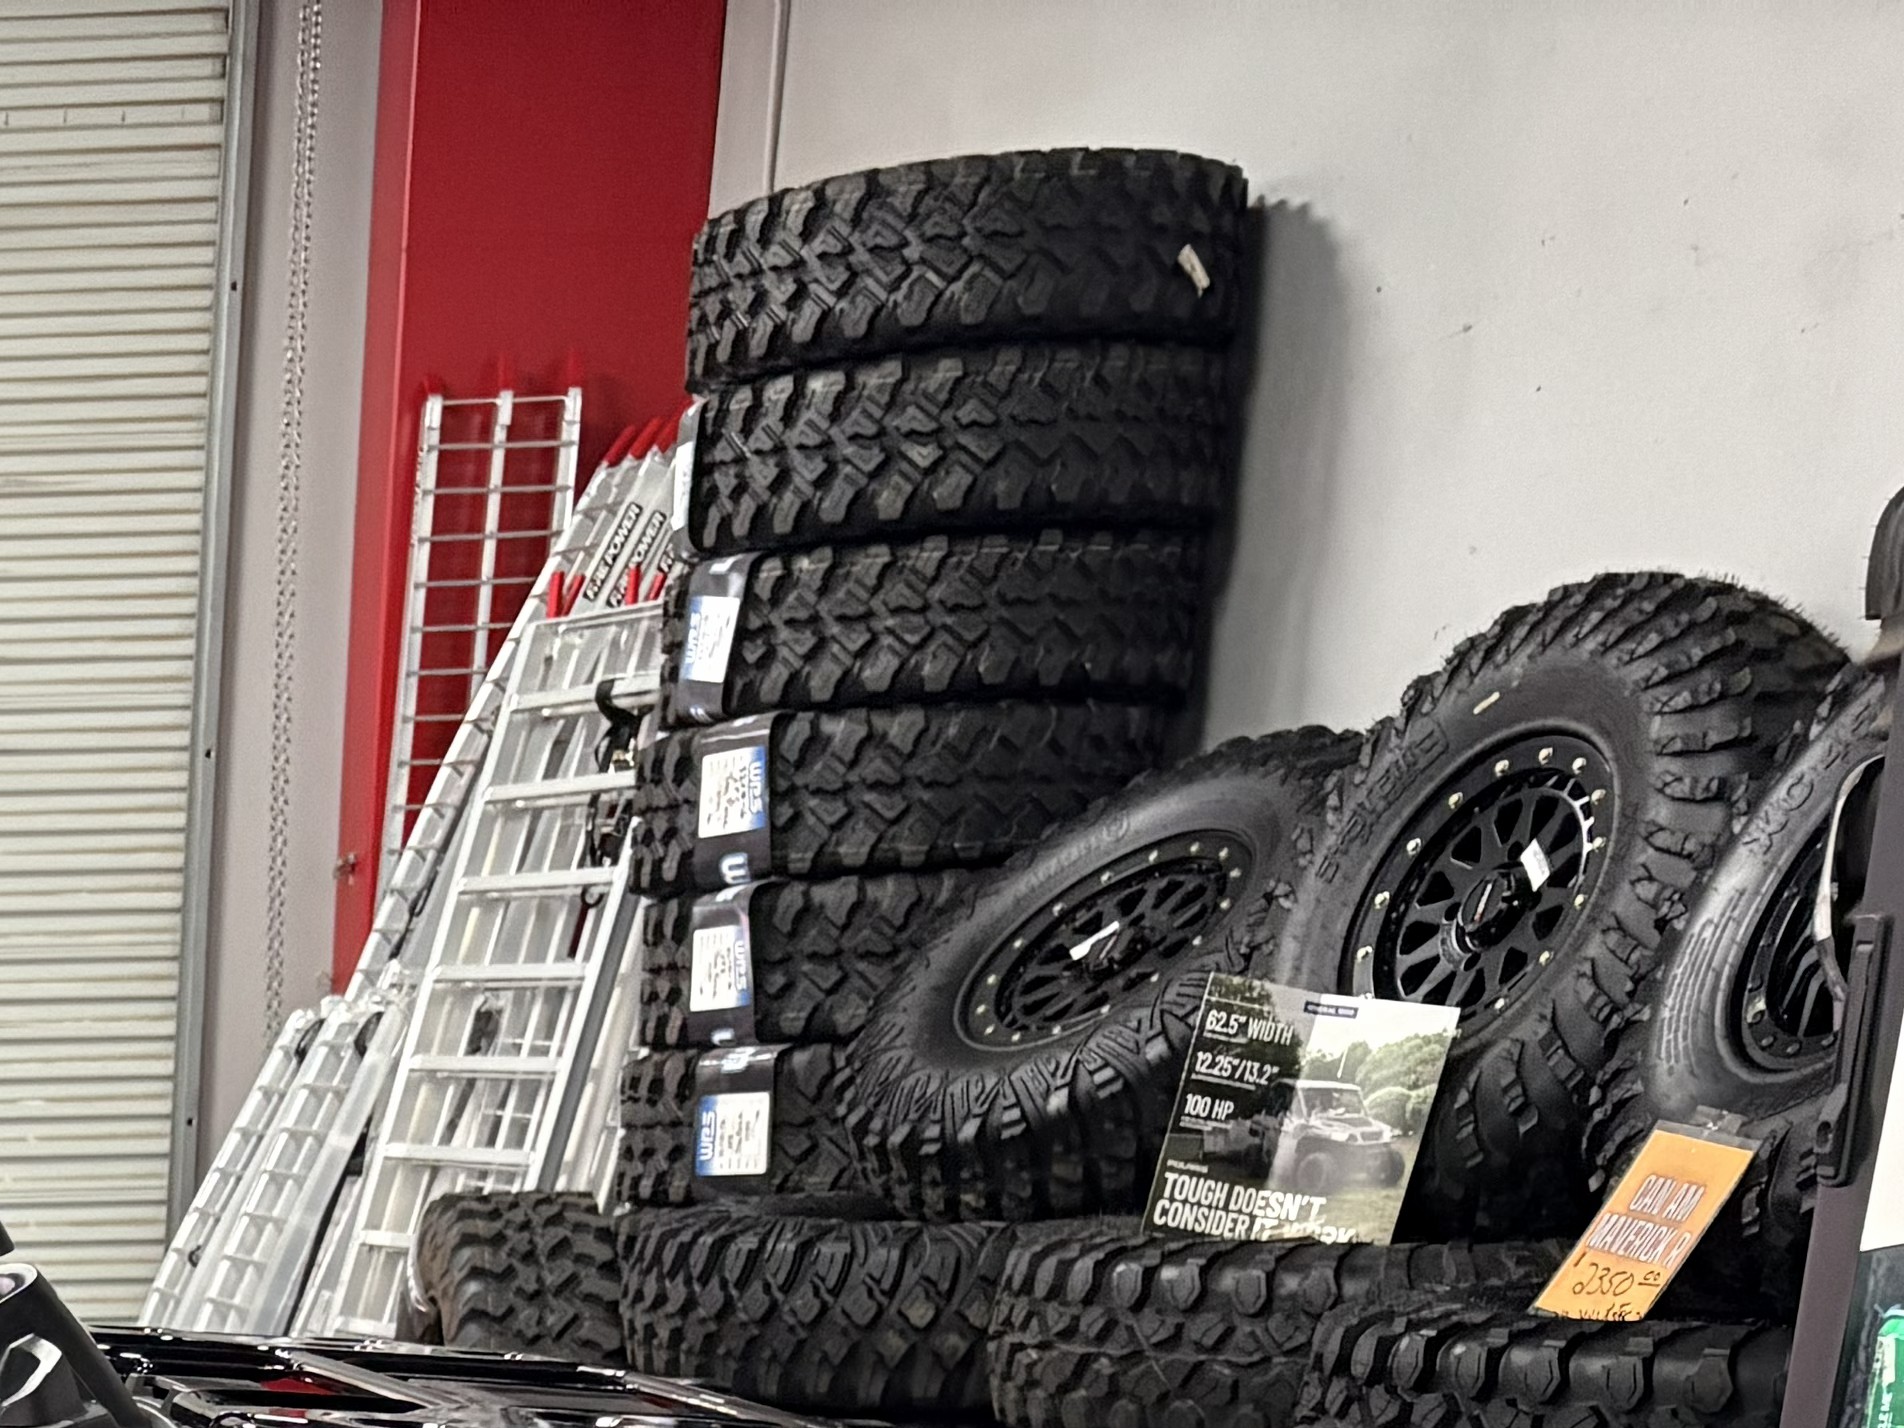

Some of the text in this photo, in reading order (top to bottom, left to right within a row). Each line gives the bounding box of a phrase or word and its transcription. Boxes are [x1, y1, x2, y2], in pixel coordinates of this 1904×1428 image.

[1247, 1019, 1293, 1046] WIDTH
[1184, 1093, 1234, 1120] 100 HP
[698, 1110, 717, 1161] WPS
[1153, 1199, 1252, 1241] CONSIDER
[1163, 1172, 1327, 1222] TOUGH DOESN'T
[1629, 1174, 1706, 1222] CAN AM
[1585, 1212, 1679, 1266] MAVERICK
